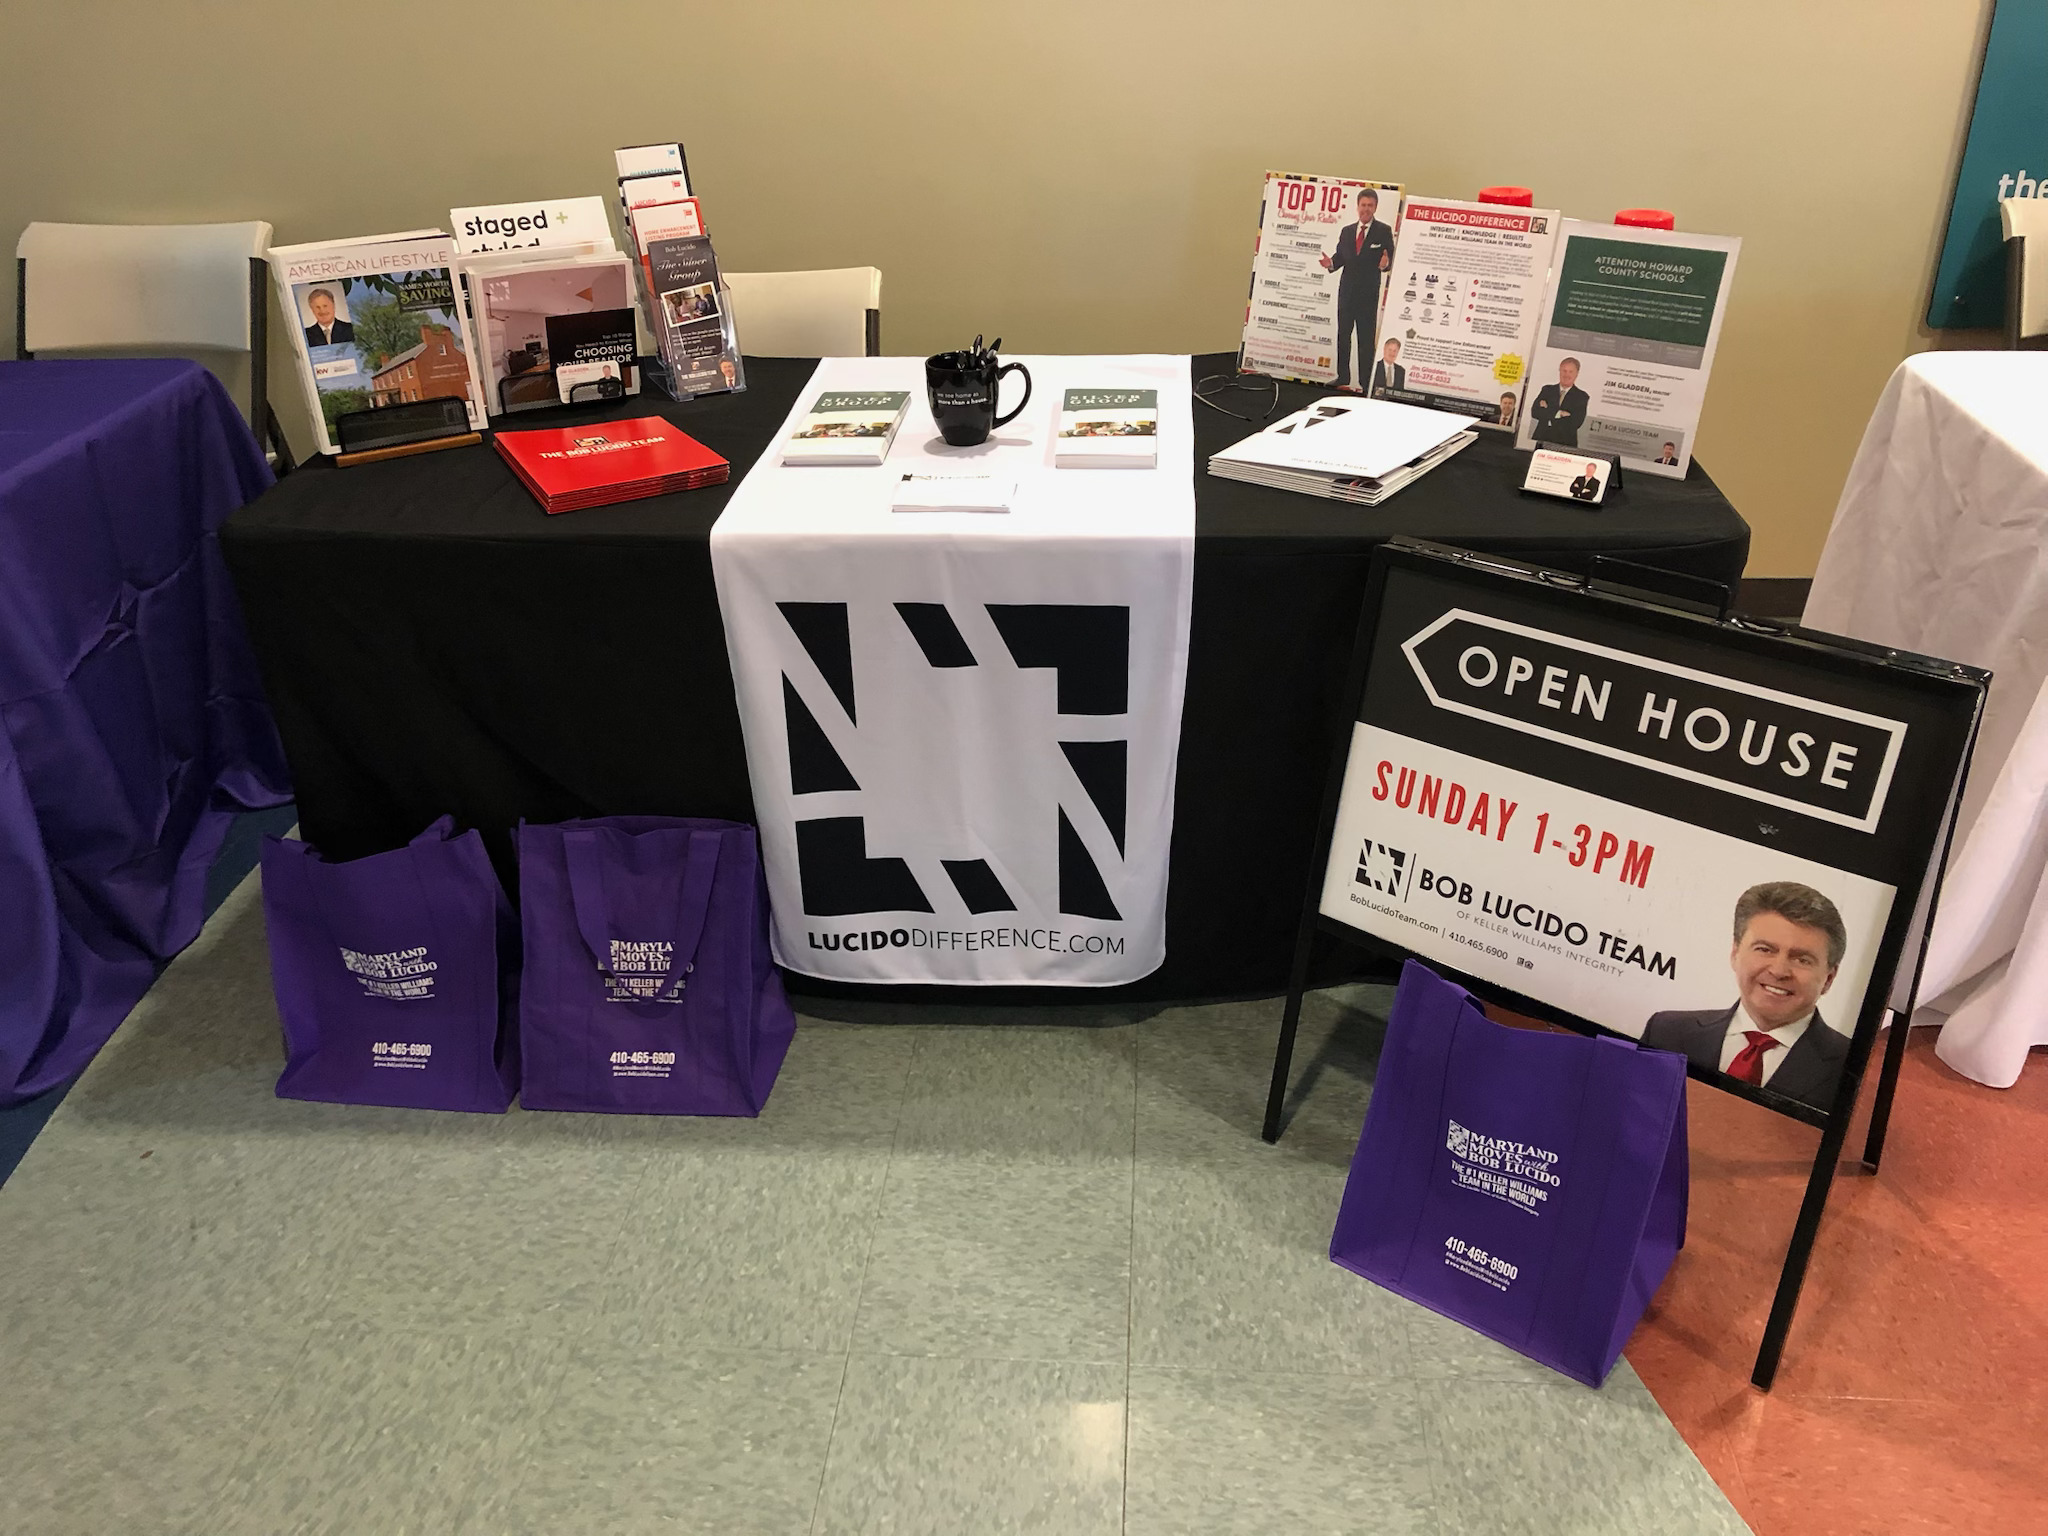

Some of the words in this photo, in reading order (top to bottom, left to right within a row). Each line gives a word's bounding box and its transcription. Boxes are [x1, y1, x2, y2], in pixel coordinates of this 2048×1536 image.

[1277, 181, 1315, 211] TOP
[1320, 186, 1348, 213] 10:
[465, 209, 548, 237] staged
[1413, 208, 1429, 219] THE
[1431, 210, 1468, 223] LUCIDO
[1469, 214, 1525, 230] DIFFERENCE
[1276, 223, 1299, 231] INTEGRITY
[1461, 236, 1483, 244] WILLIAMS
[1462, 229, 1496, 238] KNOWLEDGE
[1502, 233, 1524, 241] RESULTS
[665, 245, 676, 253] Bob
[677, 243, 696, 252] Lucido
[1296, 241, 1322, 249] KNOWLEDGE
[1270, 252, 1288, 260] RESULTS
[288, 259, 367, 278] AMERICAN
[371, 251, 448, 269] LIFESTYLE
[1595, 256, 1646, 269] ATTENTION
[1649, 263, 1693, 275] HOWARD
[668, 269, 701, 282] Group
[1598, 266, 1638, 278] COUNTY
[1639, 271, 1685, 284] SCHOOLS
[400, 287, 451, 304] SAVING
[1262, 300, 1288, 308] EXPERIENCE
[1257, 316, 1278, 324] SERVICES
[1305, 314, 1331, 323] PASSIONATE
[574, 343, 633, 358] CHOOSING
[1410, 365, 1421, 373] Jim
[1617, 382, 1652, 395] GLADDEN,
[1605, 424, 1617, 432] BOB
[1618, 426, 1640, 435] LUCIDO
[1642, 429, 1659, 438] TEAM
[590, 442, 632, 454] LUCIDO
[632, 436, 665, 447] TEAM
[1458, 645, 1614, 722] OPEN
[1637, 691, 1860, 790] HOUSE
[1371, 760, 1518, 842] SUNDAY
[1533, 812, 1656, 889] 1-3PM
[1350, 893, 1439, 934] BobLucidoTeam.com
[1448, 931, 1509, 961] 410.465.6900
[1419, 868, 1474, 906] BOB
[1481, 890, 1589, 946] LUCIDO
[1599, 931, 1677, 980] TEAM
[620, 941, 674, 952] MARYLA
[808, 928, 1125, 955] LUCIDODIFFERENCE.COM
[1456, 910, 1471, 921] OF
[1473, 916, 1510, 936] KELLER
[1512, 930, 1562, 955] WILLIAMS
[1565, 951, 1624, 977] INTEGRITY
[357, 946, 428, 962] MARYLAND
[620, 952, 664, 961] MOVES
[365, 968, 387, 978] BOB
[390, 961, 438, 978] LUCIDO
[620, 961, 646, 971] BOB
[400, 977, 434, 990] WILLIAMS
[605, 978, 618, 987] THE
[629, 978, 654, 988] KELLER
[404, 986, 428, 996] WORLD
[642, 988, 654, 997] THE
[372, 1042, 432, 1057] 410-465-6900
[609, 1051, 676, 1065] 410-465-6900
[1469, 1131, 1559, 1164] MARYLAND
[1469, 1143, 1523, 1164] MOVES
[1523, 1157, 1549, 1171] with
[1468, 1152, 1500, 1169] BOB
[1505, 1162, 1561, 1187] LUCIDO
[1451, 1160, 1464, 1175] THE
[1466, 1166, 1477, 1178] #1
[1478, 1168, 1508, 1187] KELLER
[1510, 1179, 1548, 1202] WILLIAMS
[1458, 1174, 1481, 1187] TEAM
[1482, 1180, 1491, 1190] IN
[1492, 1183, 1507, 1196] THE
[1508, 1187, 1536, 1207] WORLD
[1445, 1236, 1519, 1280] 410-465-6900
